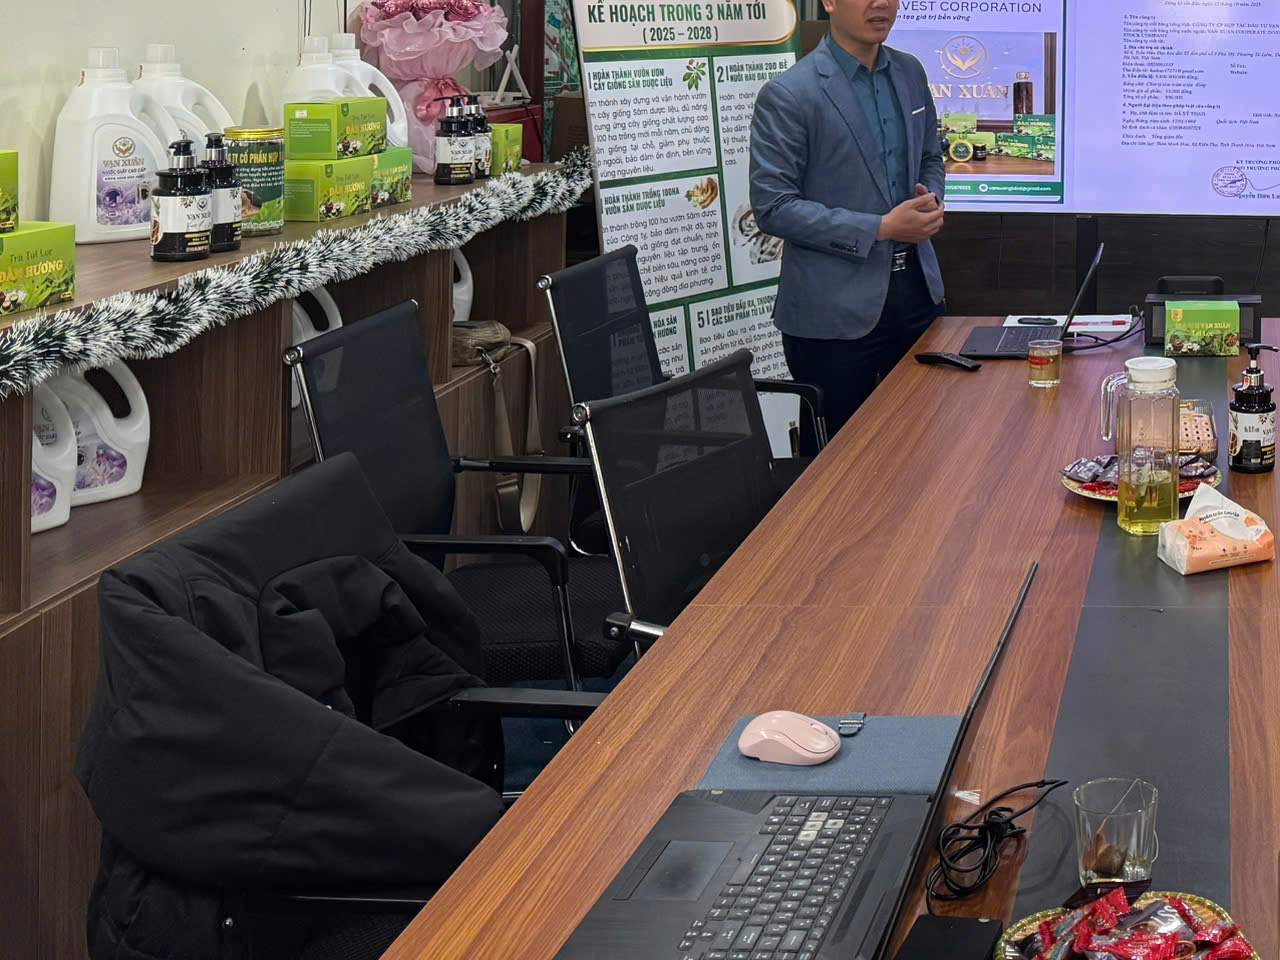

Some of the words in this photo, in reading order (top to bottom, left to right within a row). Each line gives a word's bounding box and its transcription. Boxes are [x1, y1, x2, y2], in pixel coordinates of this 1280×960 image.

[610, 4, 656, 26] HOẠCH
[659, 4, 702, 22] TRONG
[706, 4, 713, 21] 3
[717, 0, 743, 20] NĂM
[897, 1, 936, 12] VEST
[940, 1, 1042, 12] CORPORATION
[717, 66, 724, 83] 2
[960, 82, 1009, 99] XUÂN
[594, 124, 610, 132] cung
[642, 118, 660, 127] giống
[249, 149, 267, 164] PHẦN
[608, 144, 627, 155] giống
[651, 240, 669, 251] giống
[25, 259, 64, 279] HƯƠNG
[654, 275, 668, 283] hiệu
[697, 310, 704, 328] 5
